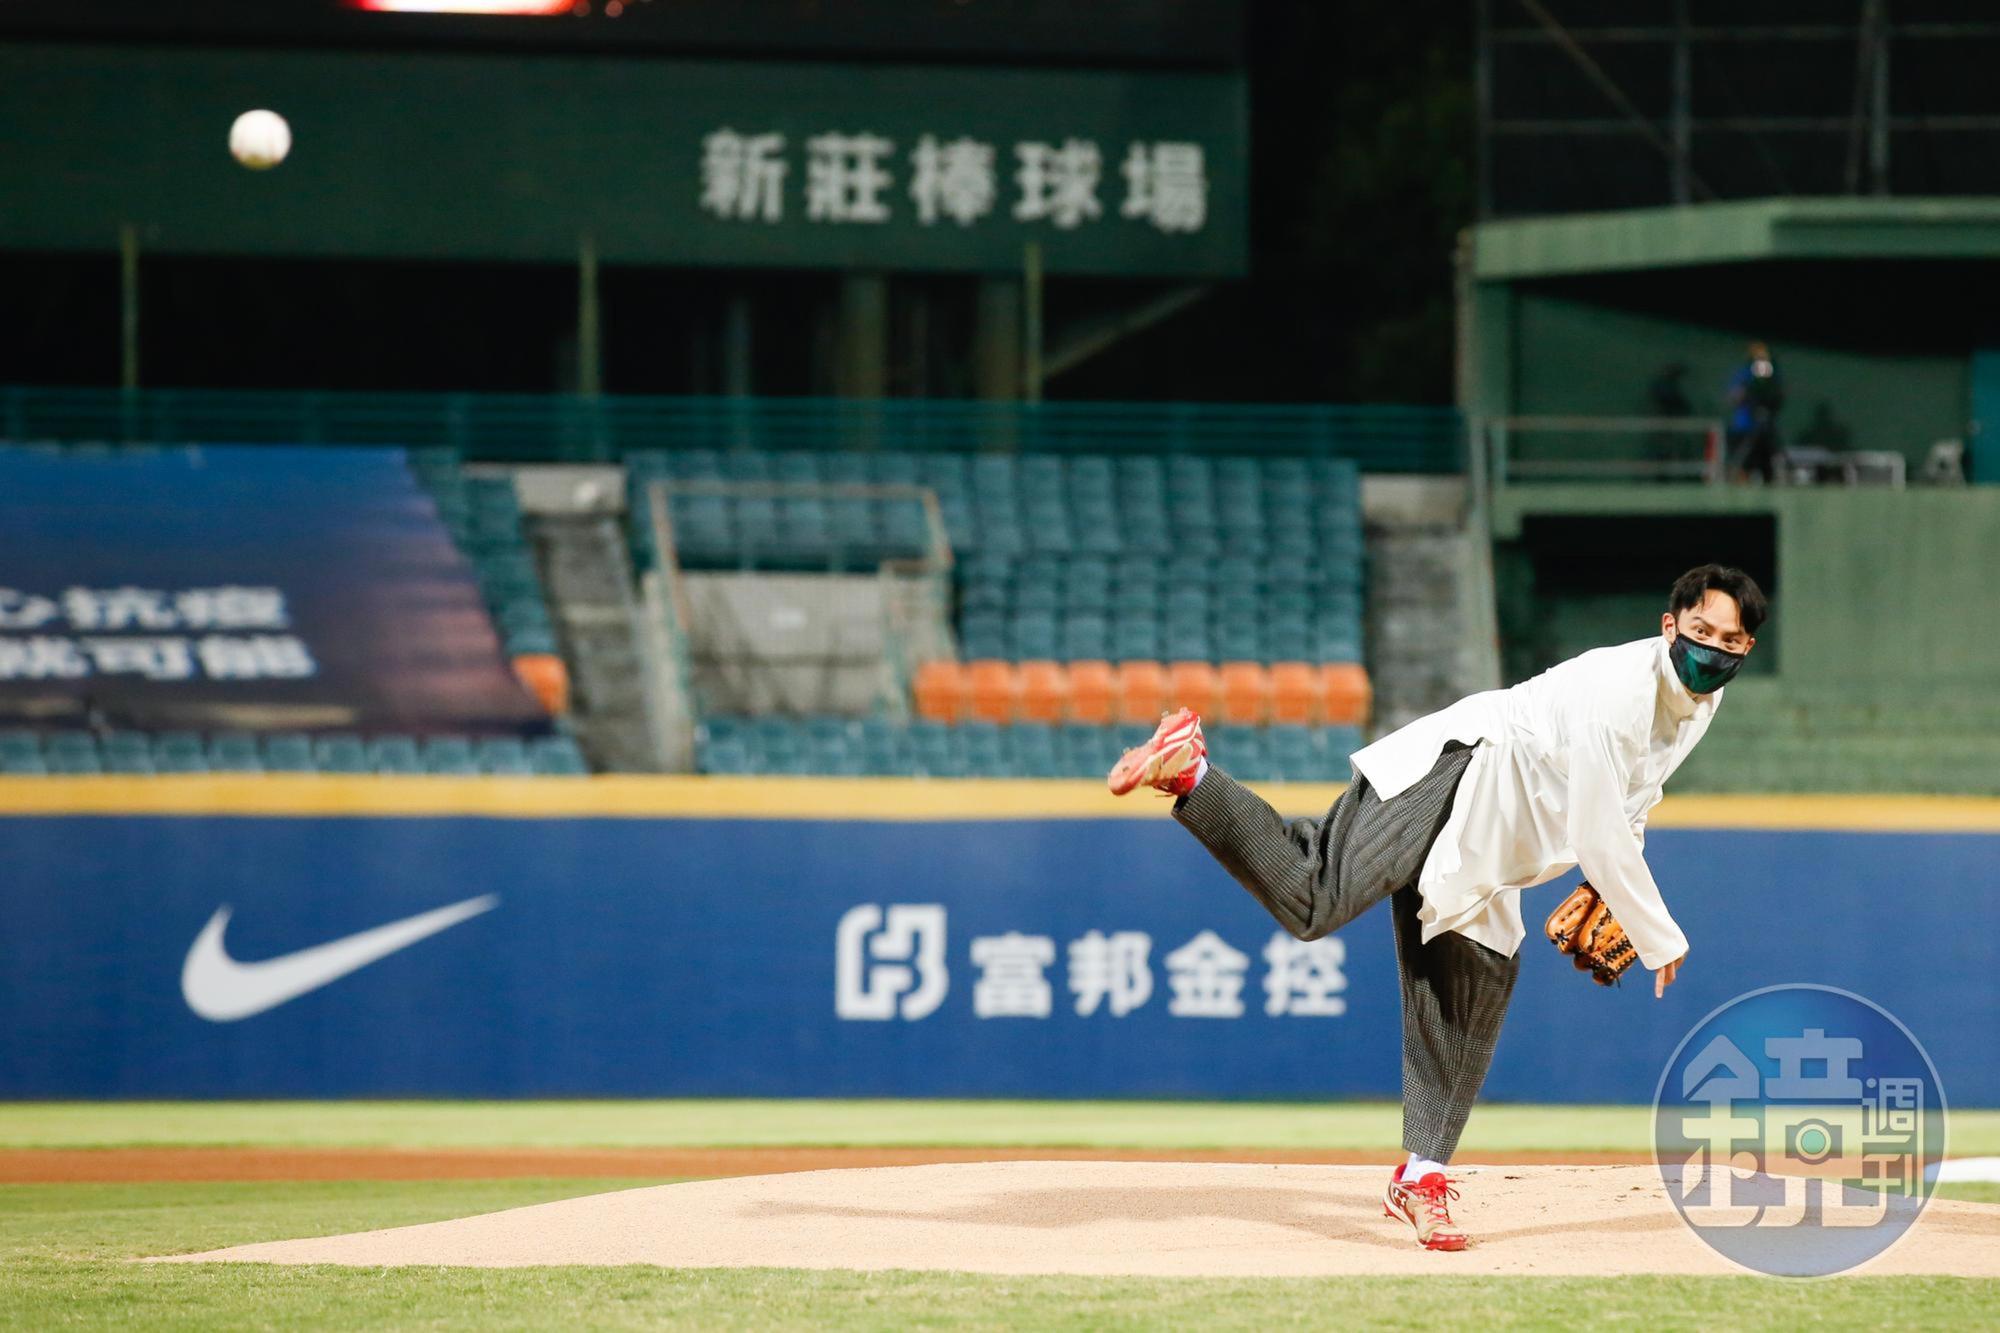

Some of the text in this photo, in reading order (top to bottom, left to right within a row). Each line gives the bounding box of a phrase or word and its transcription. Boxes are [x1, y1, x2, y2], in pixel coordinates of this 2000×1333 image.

[702, 128, 1207, 233] 新莊棒球場
[969, 930, 1348, 1019] 富邦金控
